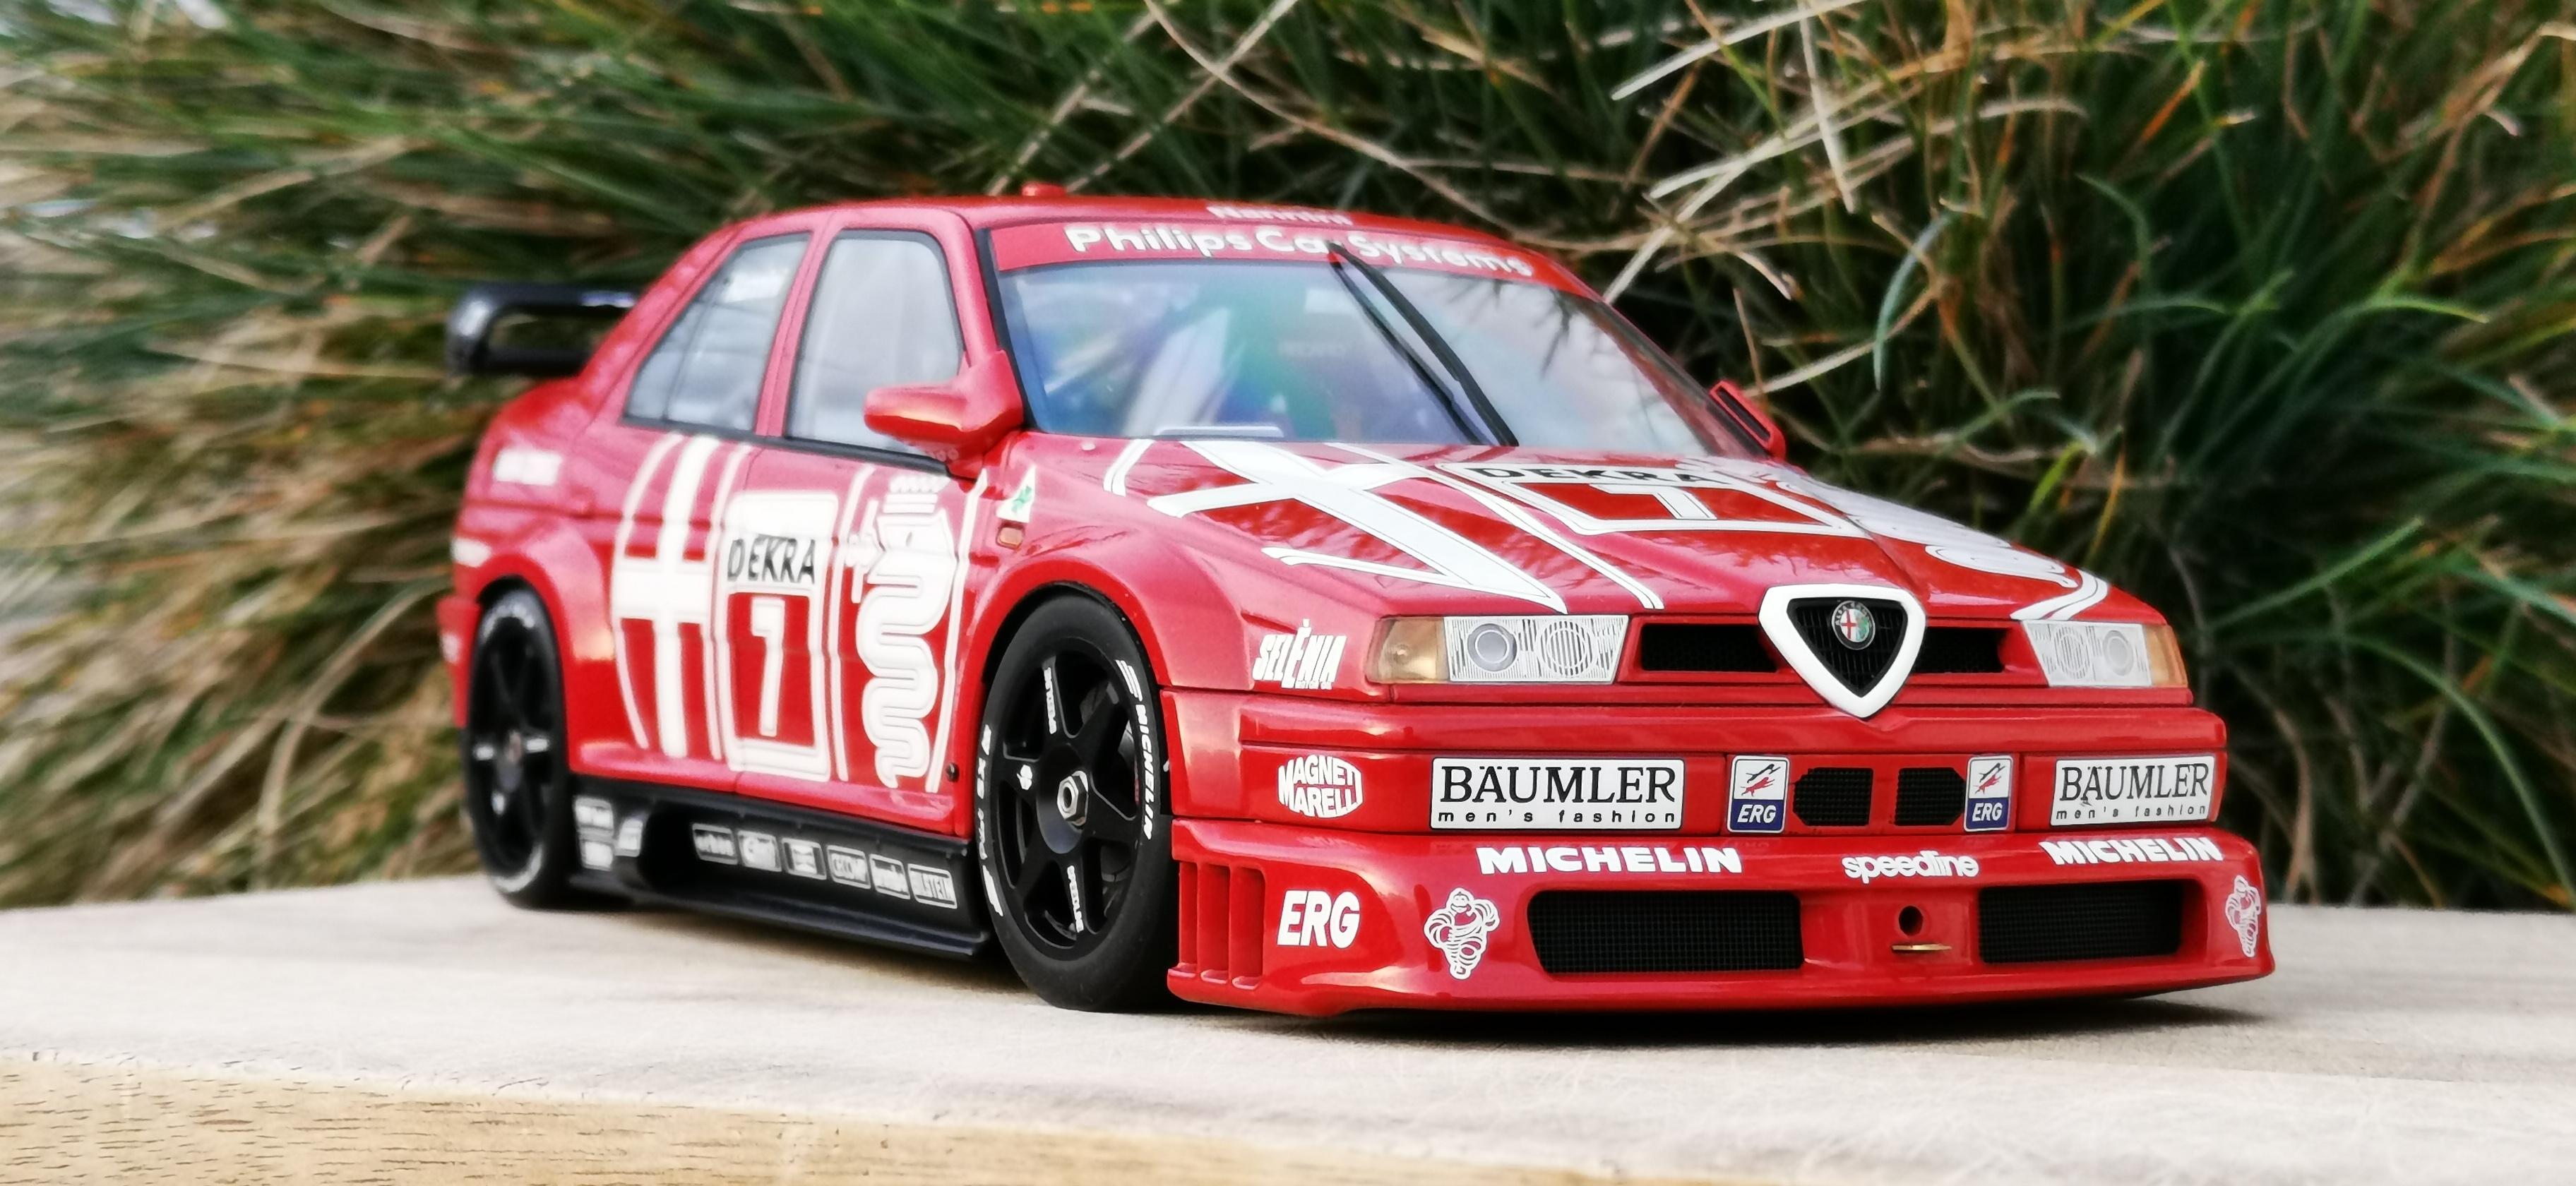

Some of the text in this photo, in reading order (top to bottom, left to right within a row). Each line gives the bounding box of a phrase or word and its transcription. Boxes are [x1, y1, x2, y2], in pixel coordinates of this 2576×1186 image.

[1063, 226, 1253, 258] Philips
[1347, 234, 1532, 277] Systems
[1465, 467, 1732, 485] DEKRA
[727, 534, 816, 585] DEKRA
[751, 597, 786, 737] 7
[1440, 766, 1676, 803] BÄUMLER
[2060, 763, 2210, 801] BÄUMLER
[1438, 809, 1676, 823] men's fashion
[1737, 804, 1777, 824] ERG
[1972, 802, 2003, 822] ERG
[2056, 805, 2206, 820] men's fashion
[1477, 846, 1743, 875] MICHELIN
[2038, 837, 2224, 865] MICHELIN
[1842, 850, 1979, 884] speedline
[1277, 890, 1361, 949] ERG
